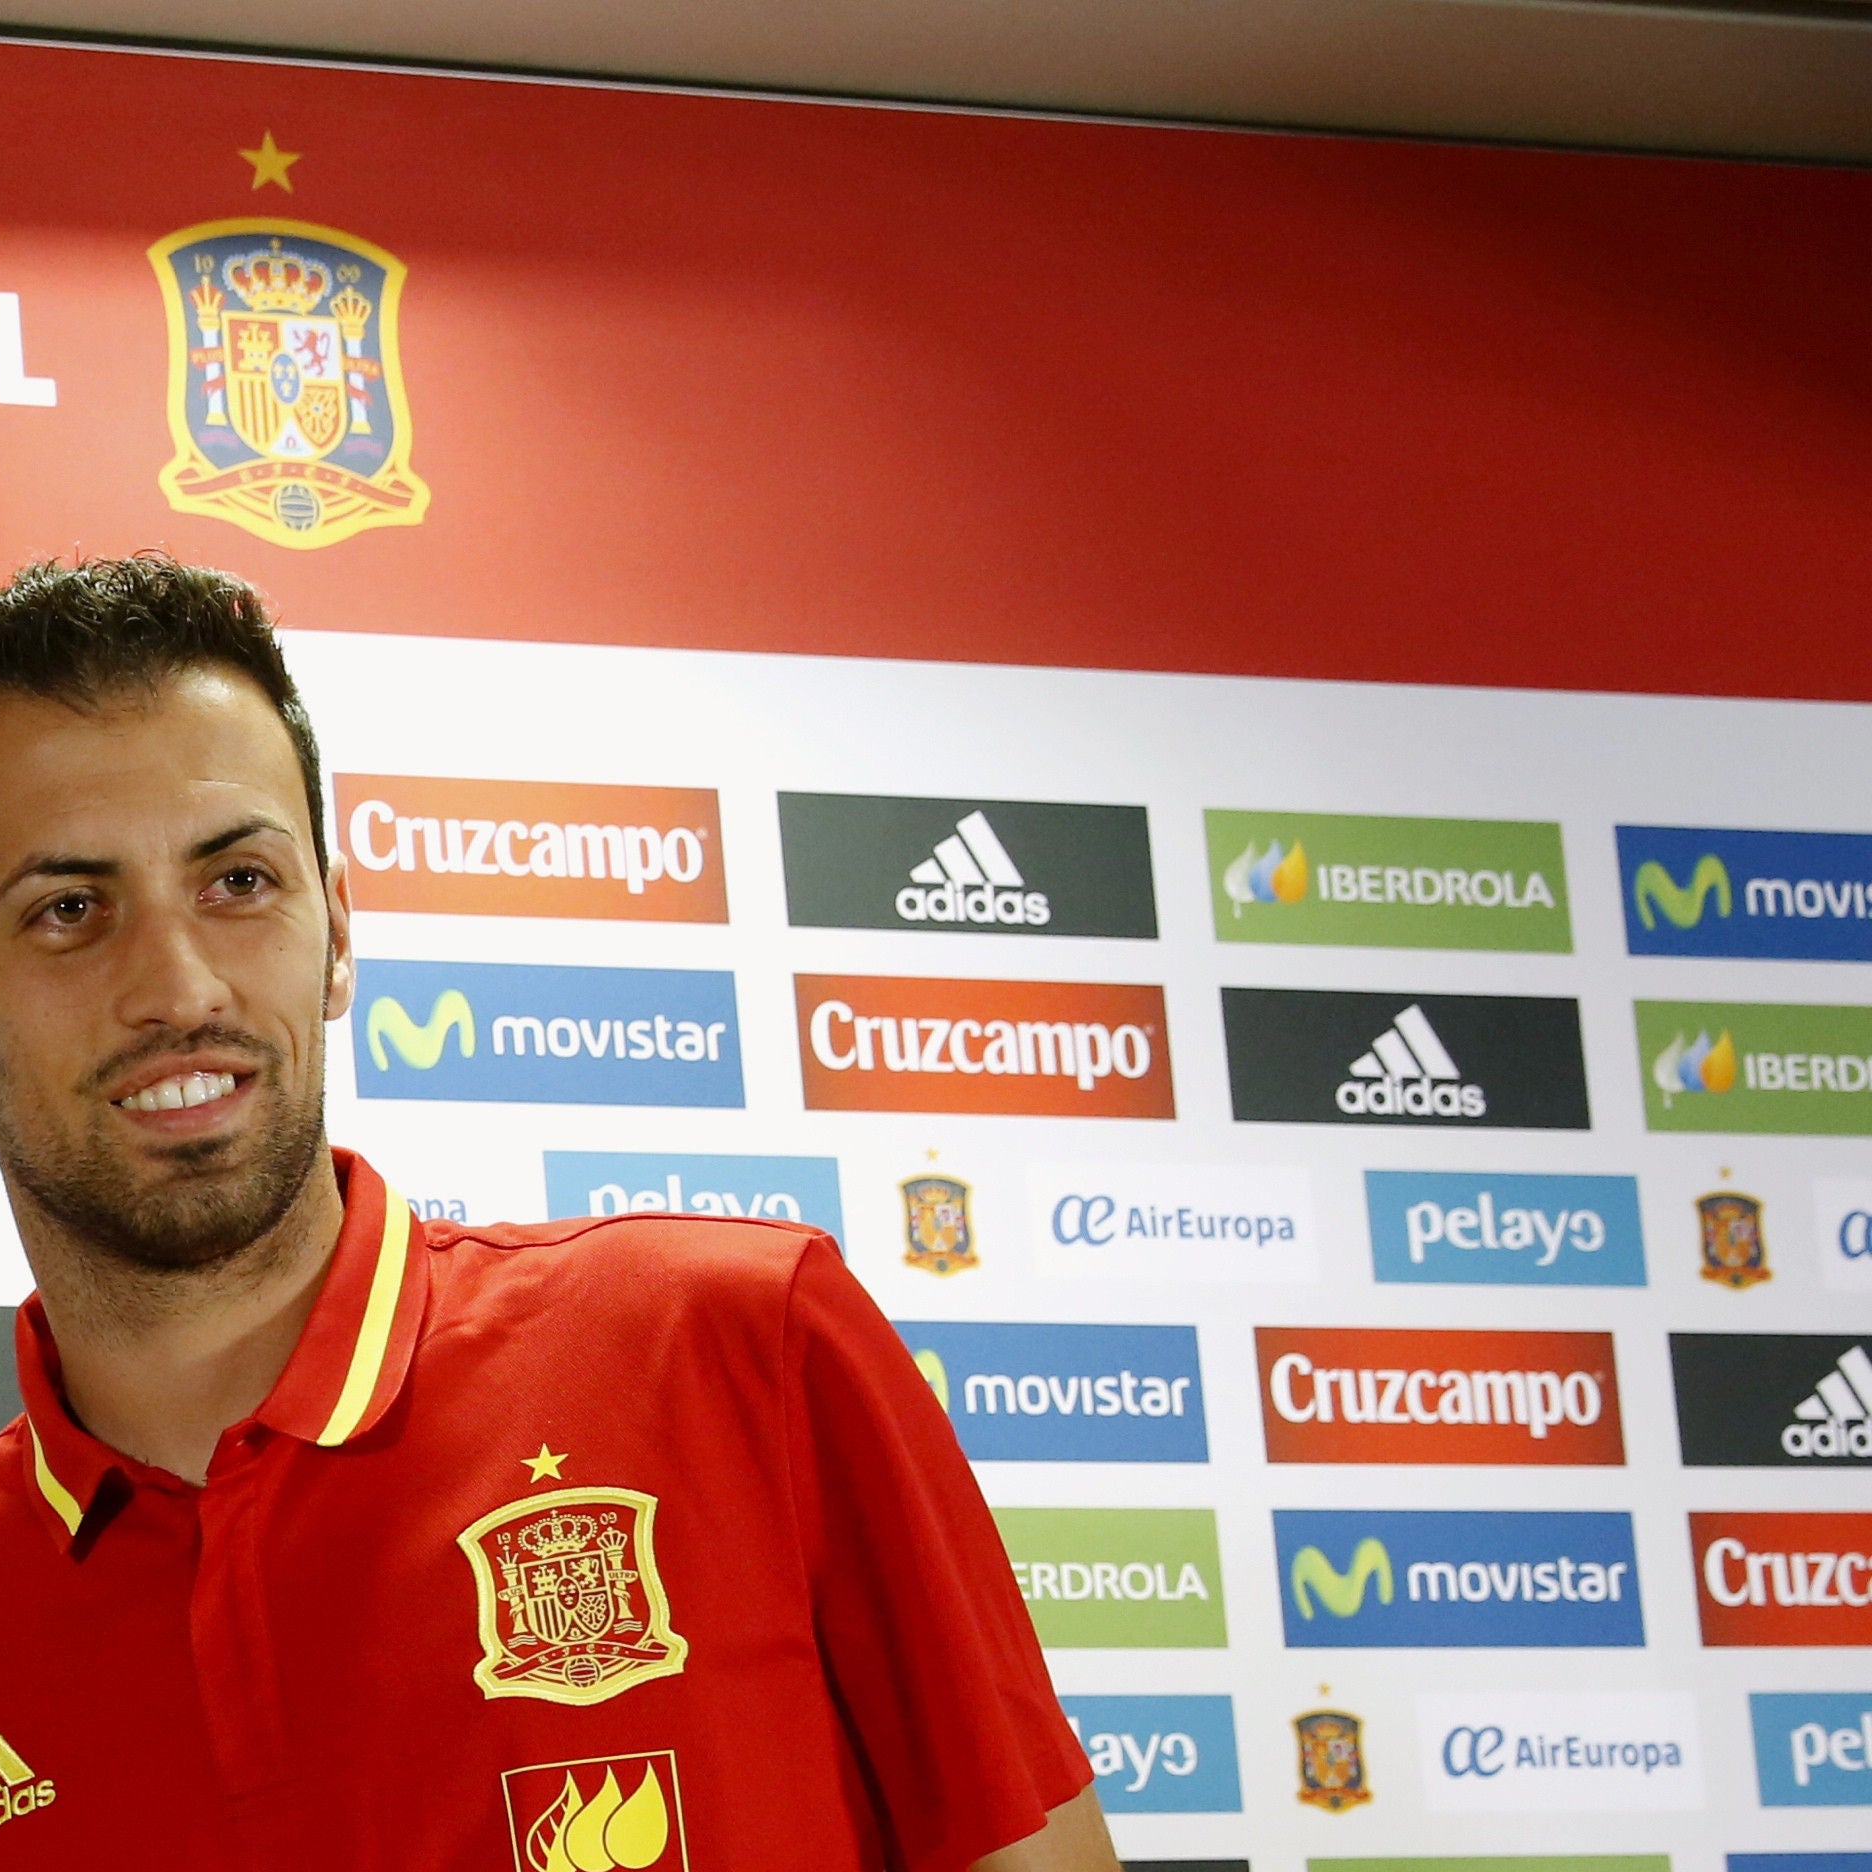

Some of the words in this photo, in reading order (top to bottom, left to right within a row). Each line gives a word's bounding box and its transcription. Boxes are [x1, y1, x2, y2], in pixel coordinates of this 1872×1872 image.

[350, 800, 702, 894] Cruzcampo
[895, 882, 1050, 926] adidas
[1317, 864, 1555, 910] IBERDROLA
[493, 1011, 726, 1063] movistar
[810, 999, 1149, 1090] Cruzcampo
[1746, 1053, 1872, 1093] IBERD
[1336, 1077, 1486, 1118] adidas
[1125, 1206, 1295, 1248] AirEuropa
[1407, 1193, 1606, 1264] pelayo
[966, 1369, 1189, 1417] movistar
[1269, 1353, 1601, 1437] Cruzcampo
[1013, 1561, 1207, 1601] ERDROLA
[1408, 1556, 1627, 1602] movistar
[1704, 1538, 1872, 1607] Cruzc
[1516, 1734, 1682, 1775] AirEuropa
